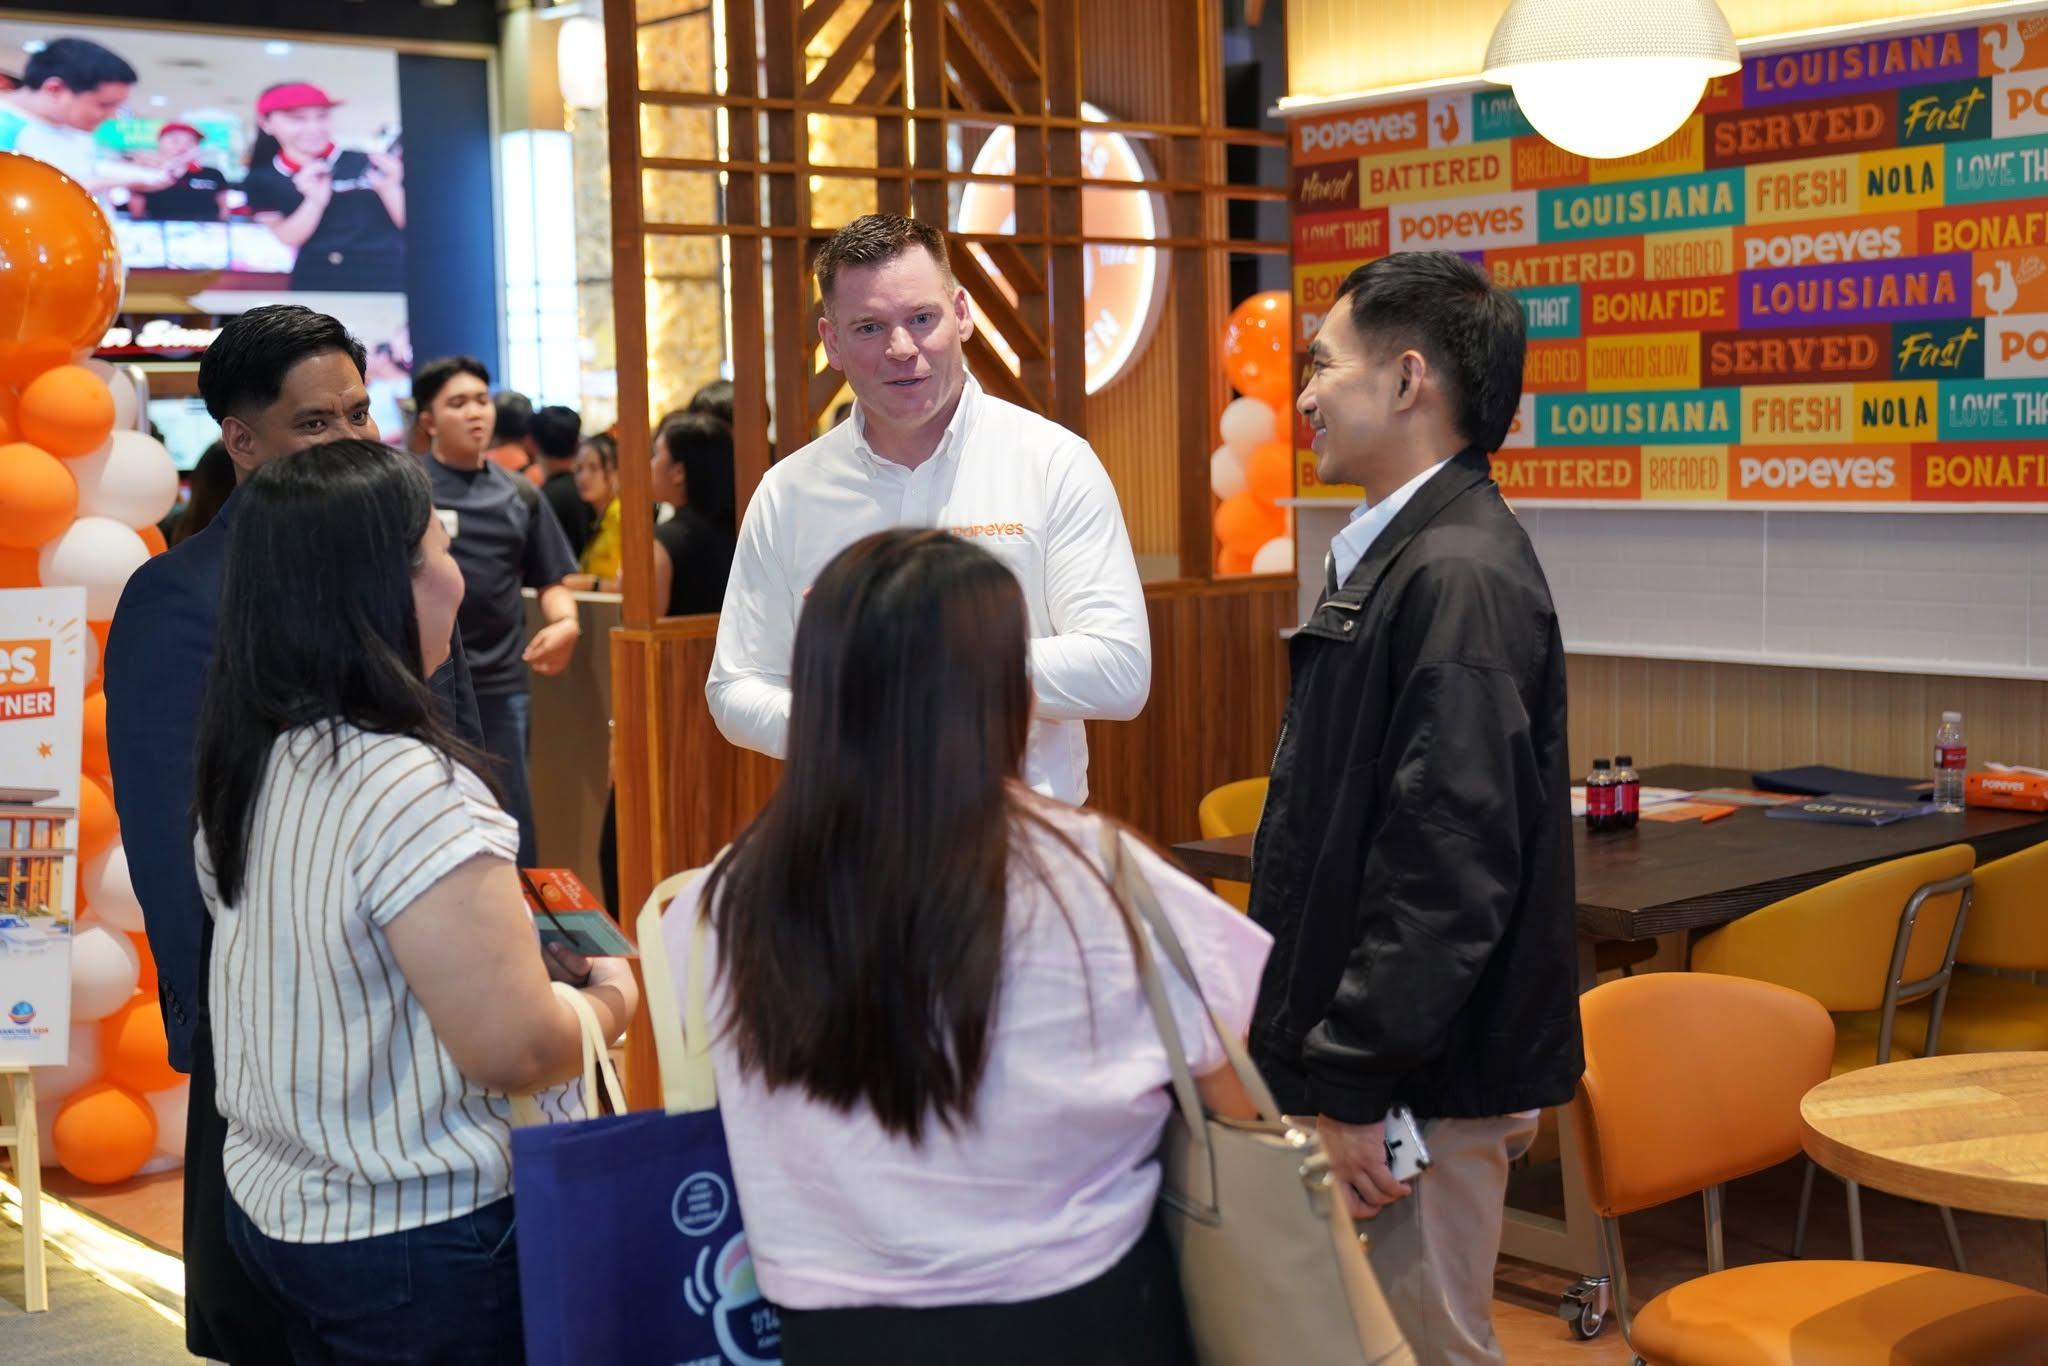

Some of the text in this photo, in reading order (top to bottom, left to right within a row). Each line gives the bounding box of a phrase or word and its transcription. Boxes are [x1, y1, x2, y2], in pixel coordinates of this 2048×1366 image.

[1756, 32, 1964, 91] LOUISIANA
[1714, 103, 1886, 156] SERVED
[1904, 87, 1985, 138] Fast
[1369, 155, 1499, 194] BATTERED
[1867, 161, 1935, 197] NOLA
[1956, 152, 2015, 190] LOVE
[1554, 181, 1734, 229] LOUISIANA
[1756, 168, 1847, 212] FRESH
[1344, 219, 1382, 249] THAT
[1493, 251, 1636, 289] BATTERED
[1653, 240, 1722, 279] BREADED
[1593, 288, 1725, 323] BONAFIDE
[1752, 271, 1956, 314] LOUISIANA
[1527, 297, 1570, 327] THAT
[1525, 348, 1579, 383] READED
[1592, 344, 1689, 379] COOKED SLOW
[1710, 334, 1879, 376] SERVED
[1899, 326, 1979, 371] Fast
[1551, 401, 1729, 434] LOUISIANA
[1752, 397, 1842, 434] FRESH
[1862, 396, 1928, 427] NOLA
[1950, 394, 2008, 428] LOVE
[1493, 459, 1632, 488] BATTERED
[1650, 456, 1719, 491] BREADED
[1926, 454, 2048, 488] BONAFI
